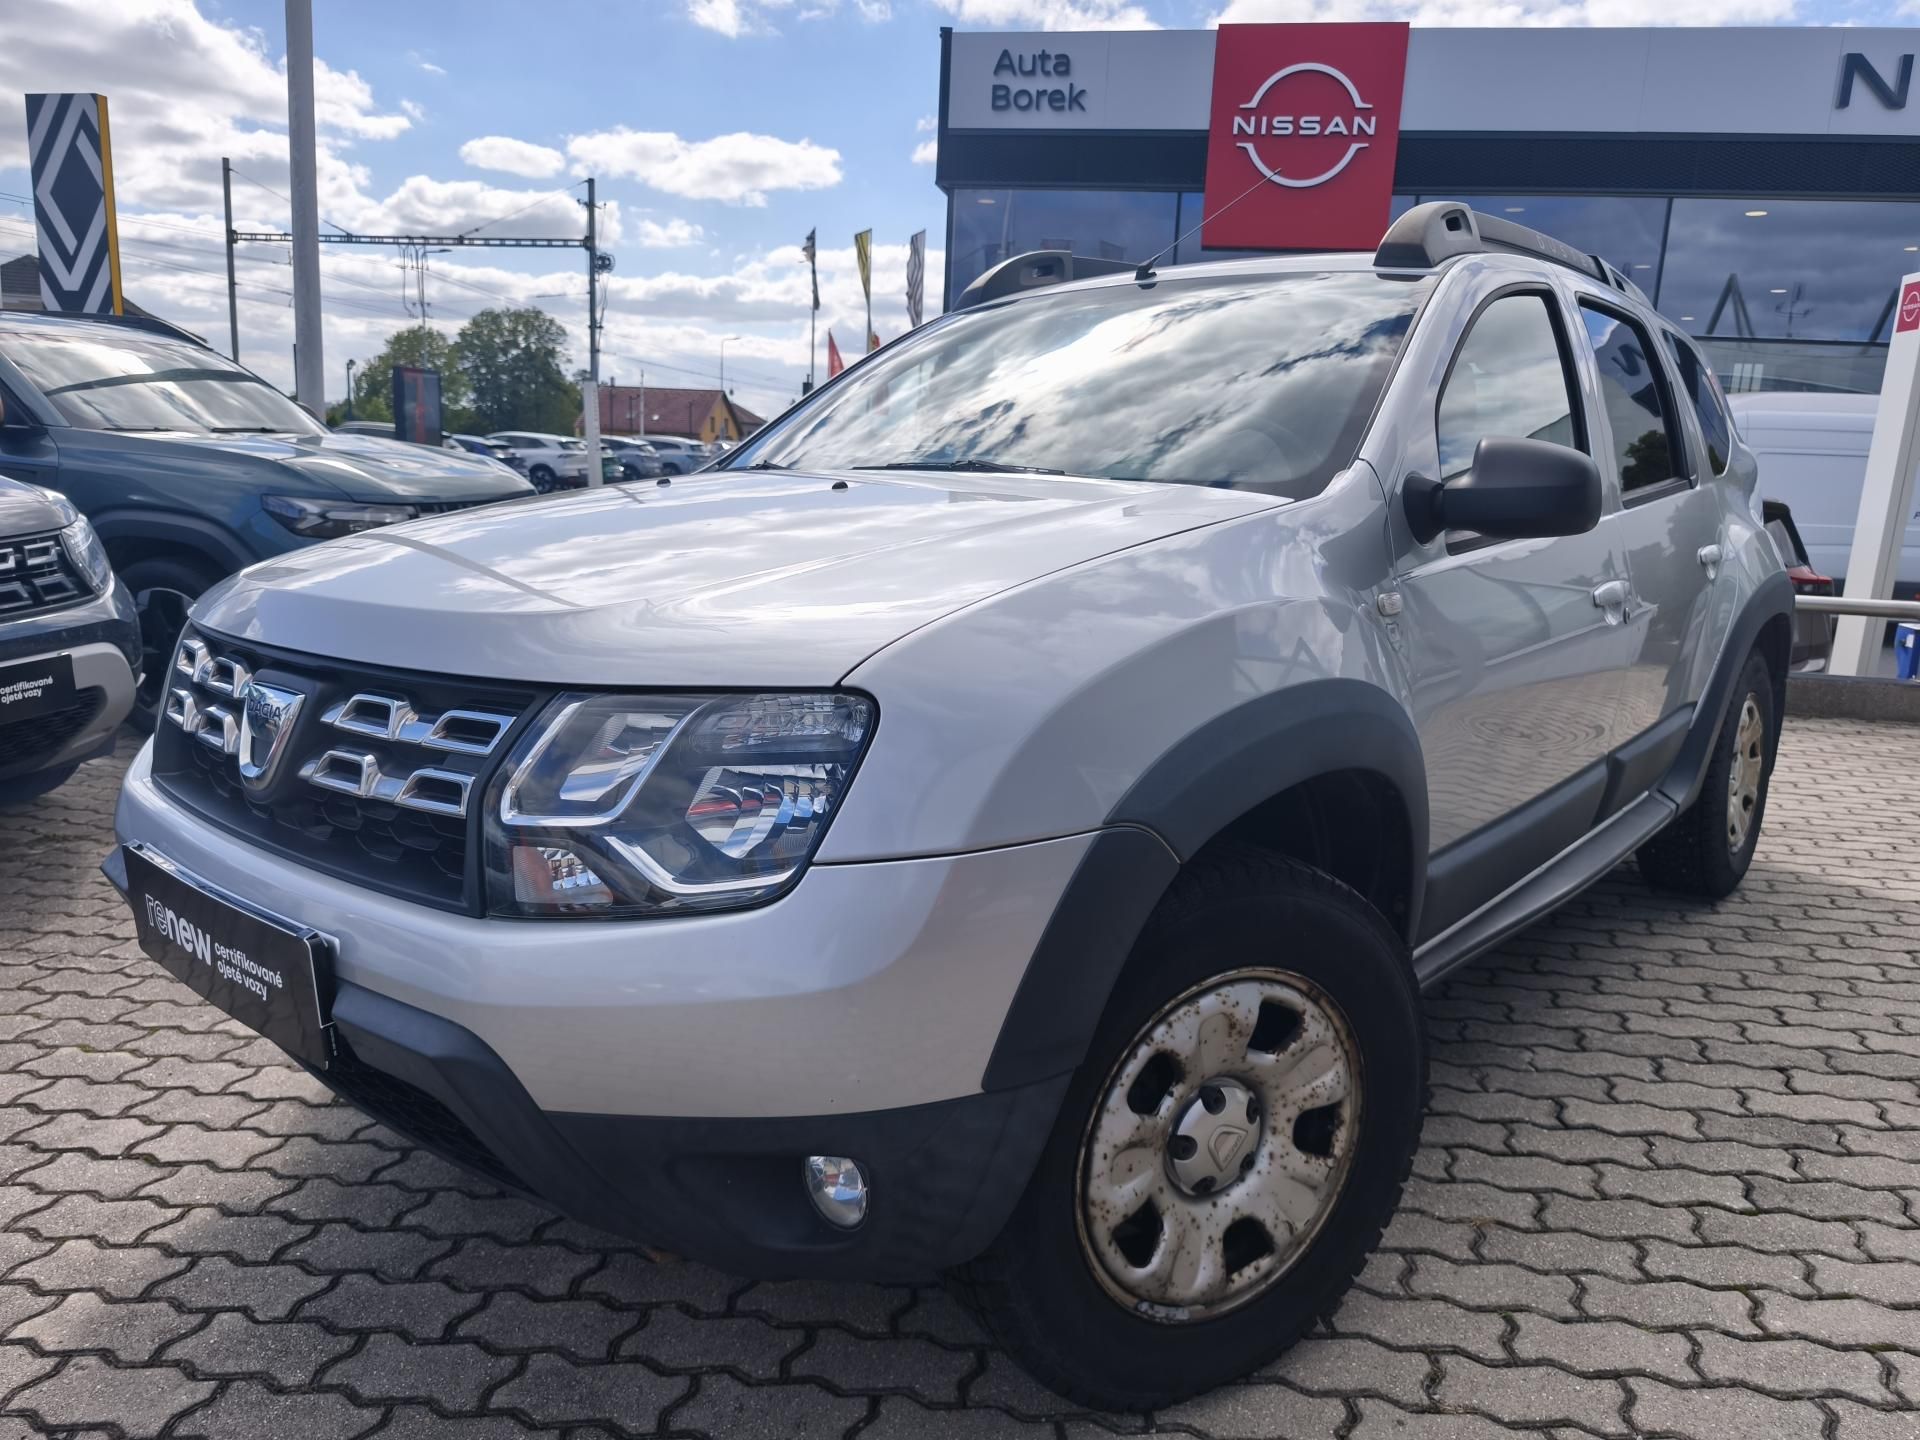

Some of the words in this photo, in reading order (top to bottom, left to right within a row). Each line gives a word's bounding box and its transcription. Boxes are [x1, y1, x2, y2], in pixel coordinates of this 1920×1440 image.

[993, 48, 1071, 77] Auta
[991, 82, 1087, 112] Borek
[1834, 52, 1915, 110] N
[1232, 115, 1377, 136] NISSAN
[246, 699, 282, 721] DACIA
[145, 893, 212, 967] renew
[214, 942, 283, 988] certifikované
[217, 959, 243, 984] ojeté
[243, 973, 267, 1001] vozy
